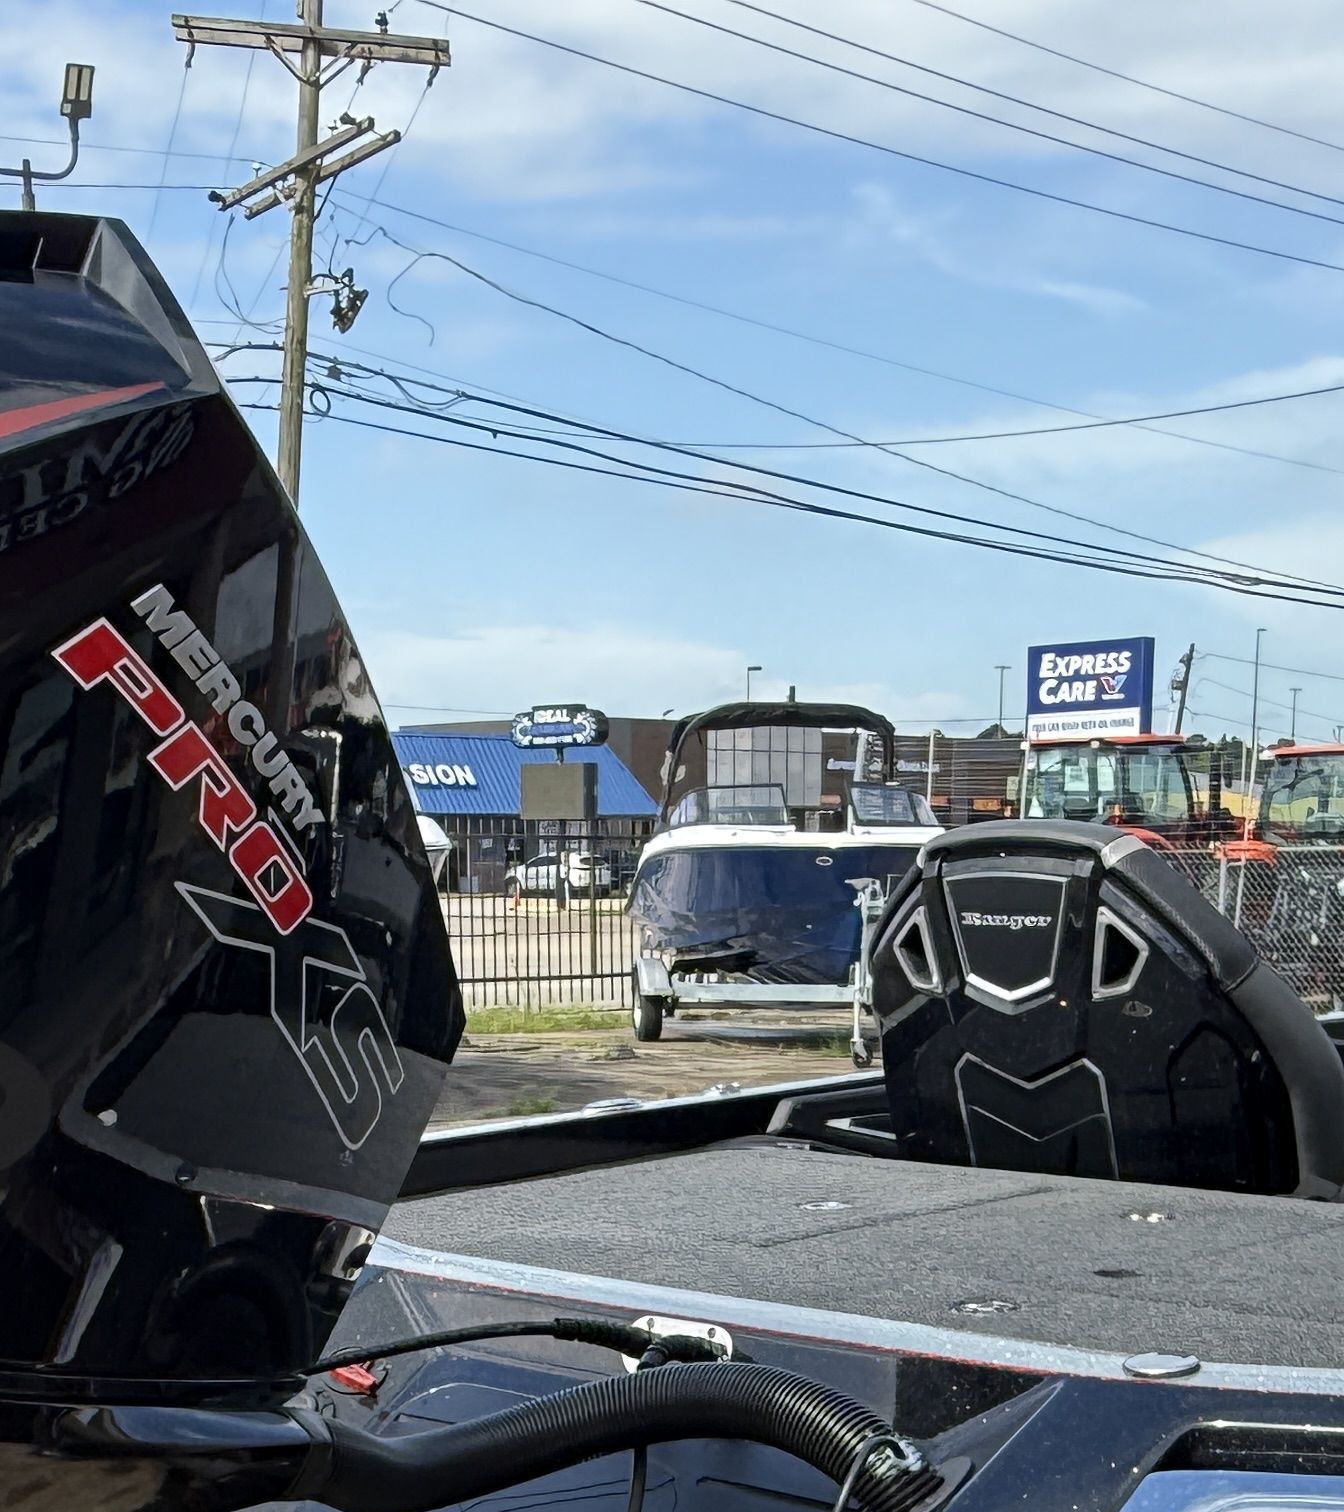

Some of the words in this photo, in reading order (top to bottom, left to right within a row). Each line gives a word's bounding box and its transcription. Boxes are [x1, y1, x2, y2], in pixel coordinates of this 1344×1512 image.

[1039, 651, 1132, 678] EXPRESS
[1039, 678, 1097, 704] CARE
[130, 583, 325, 830] MERCURY
[51, 617, 313, 935] PRO
[409, 763, 477, 785] SION
